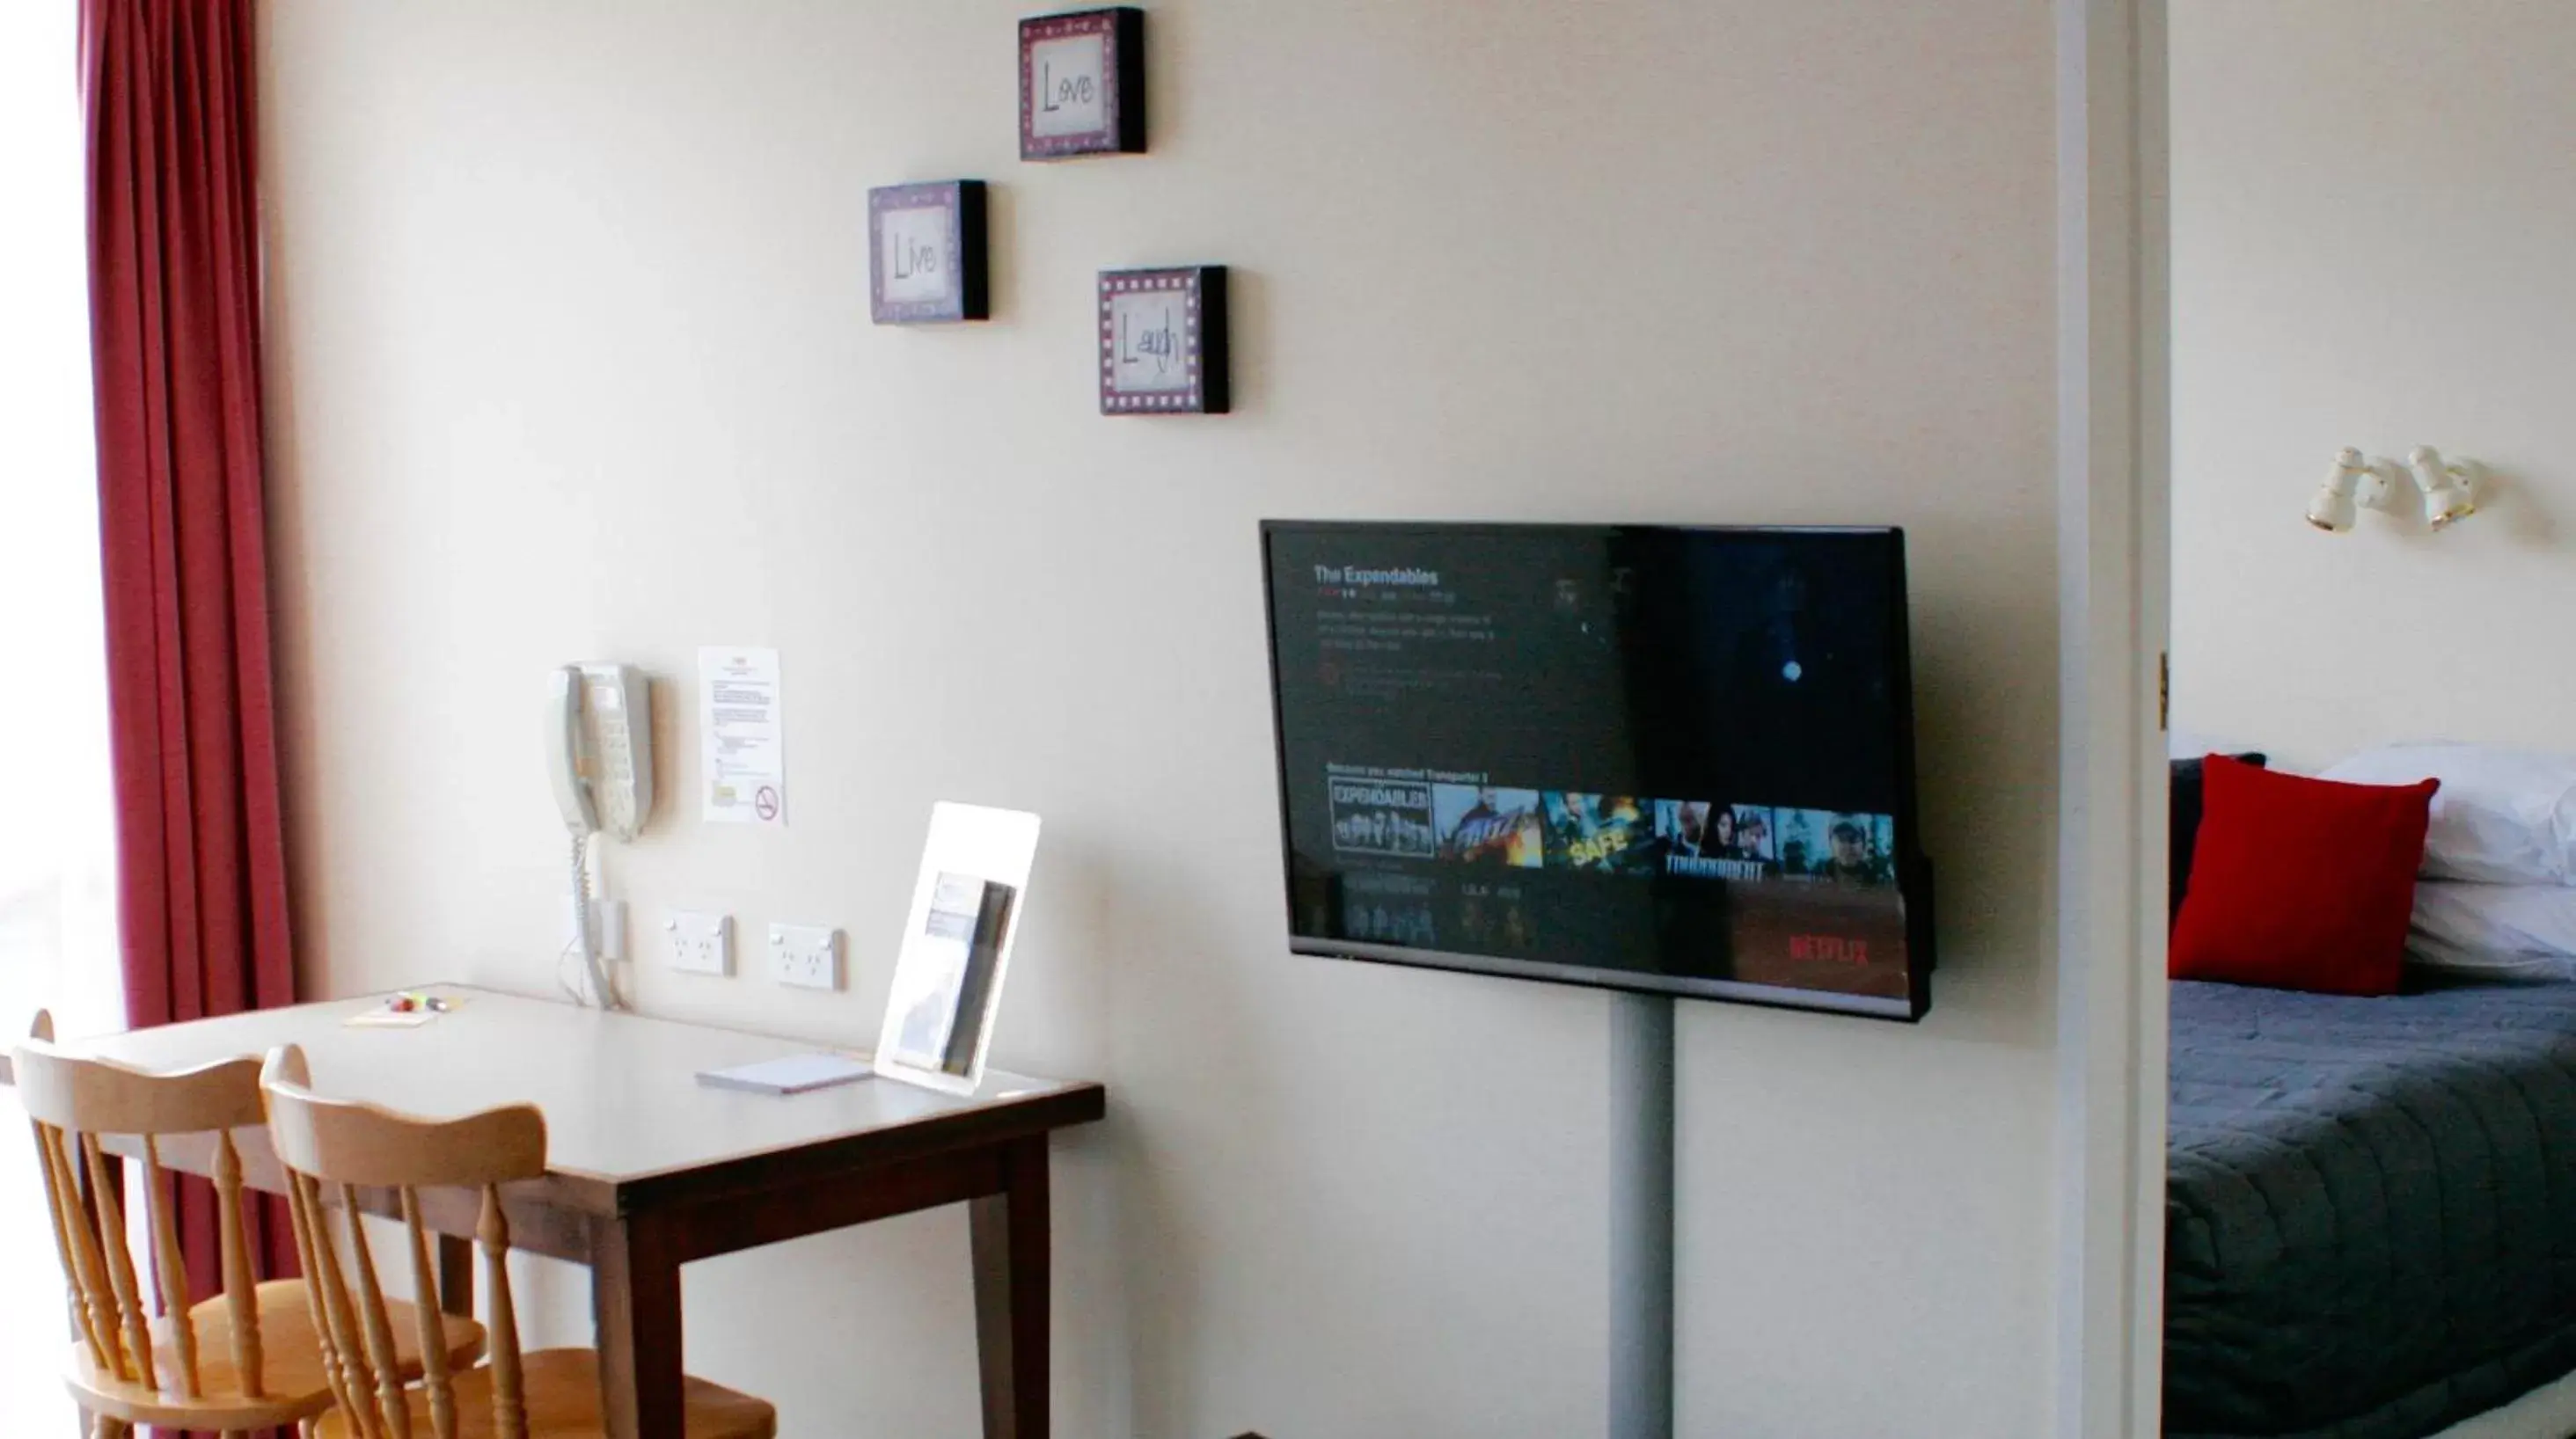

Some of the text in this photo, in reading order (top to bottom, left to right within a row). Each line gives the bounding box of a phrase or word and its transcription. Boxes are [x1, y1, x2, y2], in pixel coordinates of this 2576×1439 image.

[1042, 60, 1094, 113] Love
[894, 232, 937, 280] Live
[1122, 305, 1180, 374] Laugh
[1314, 564, 1439, 588] The Expendables
[1569, 828, 1628, 866] SAFE
[1789, 932, 1870, 966] NETFLIX
